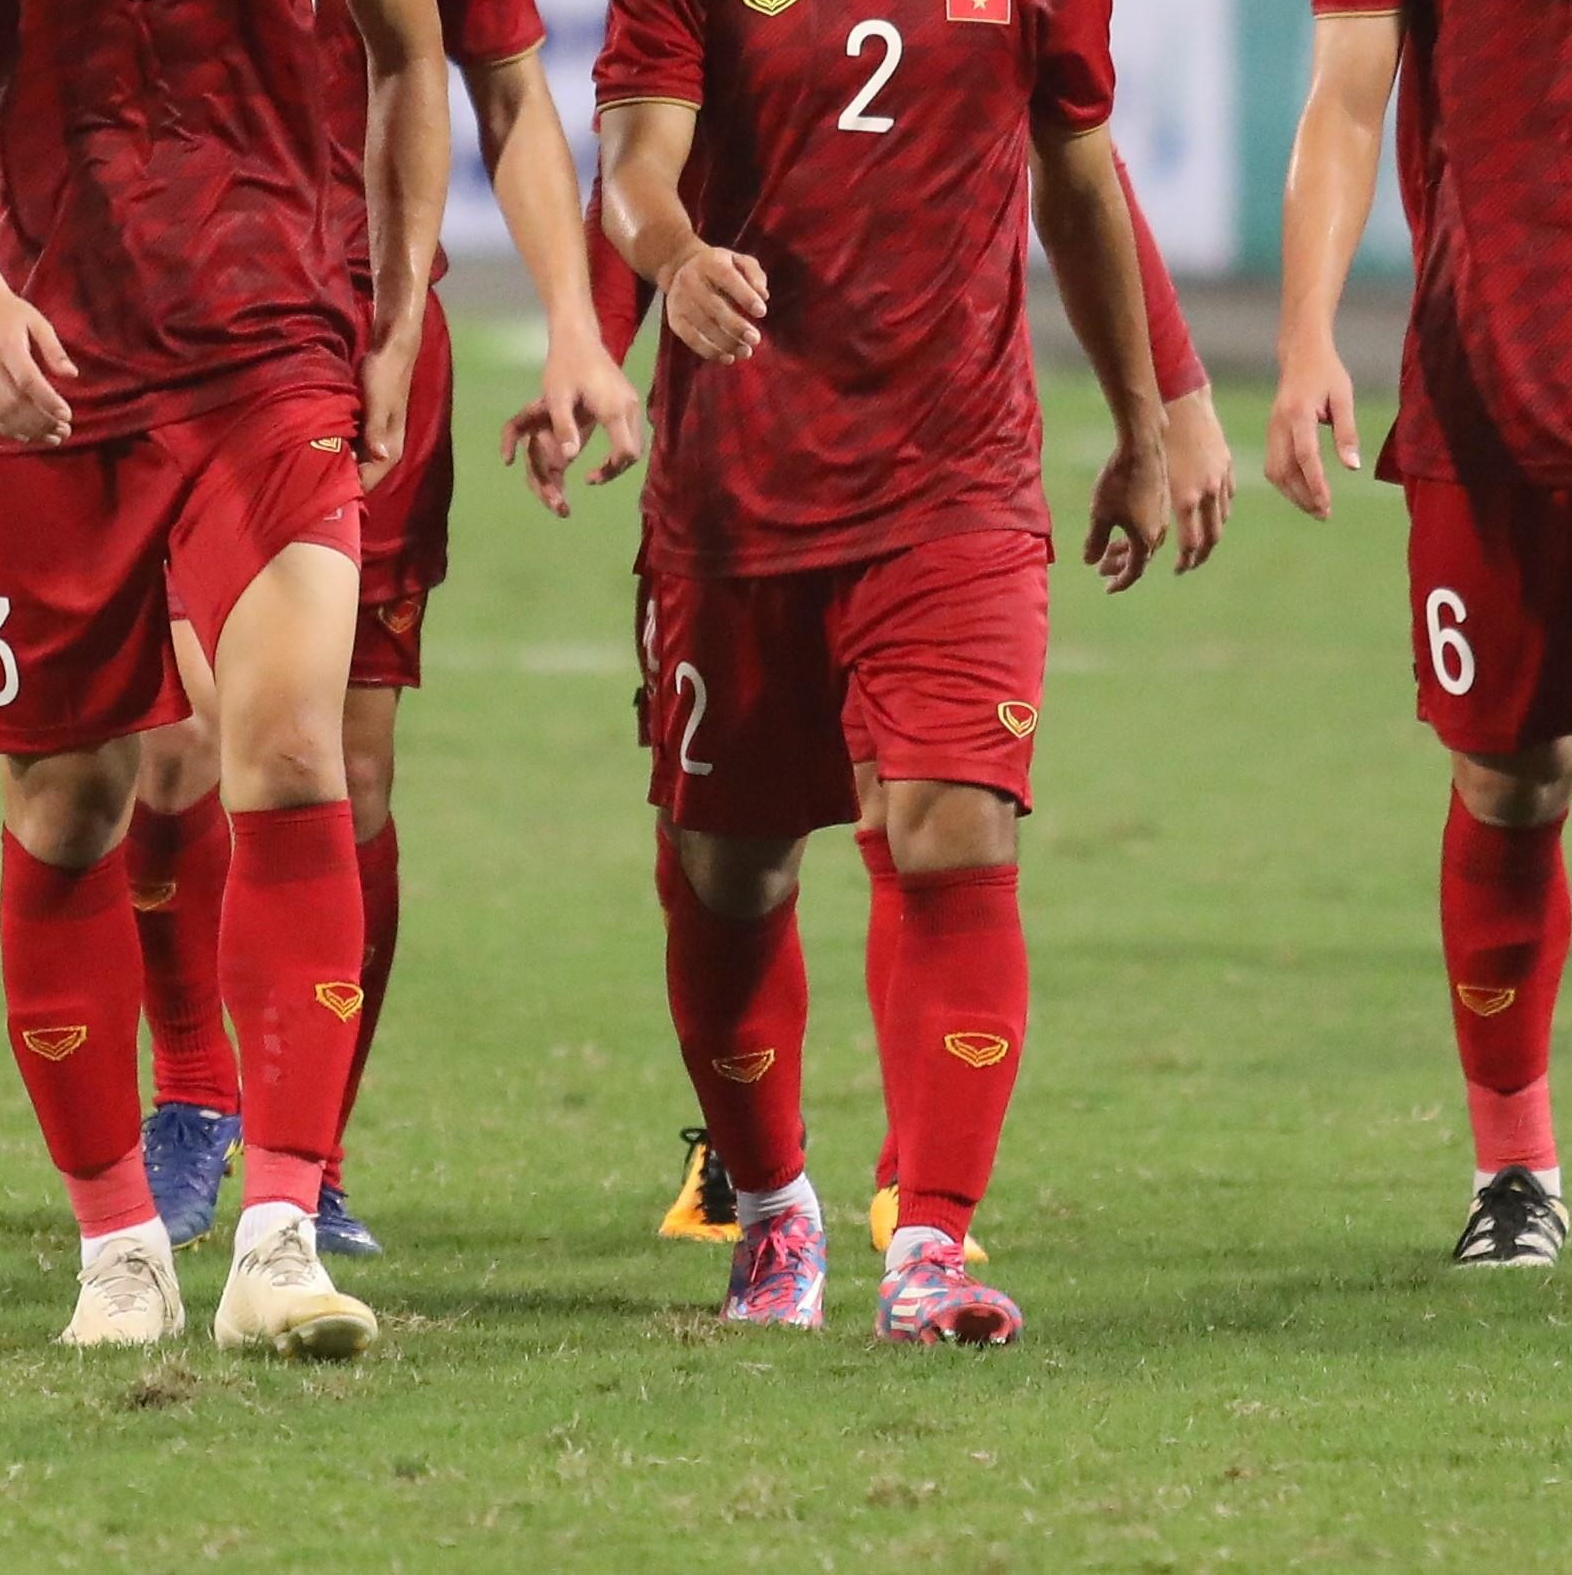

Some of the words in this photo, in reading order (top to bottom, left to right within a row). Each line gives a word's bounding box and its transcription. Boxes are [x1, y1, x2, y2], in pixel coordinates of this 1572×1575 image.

[837, 18, 903, 133] 2
[1426, 587, 1480, 696] 6
[675, 661, 713, 776] 2
